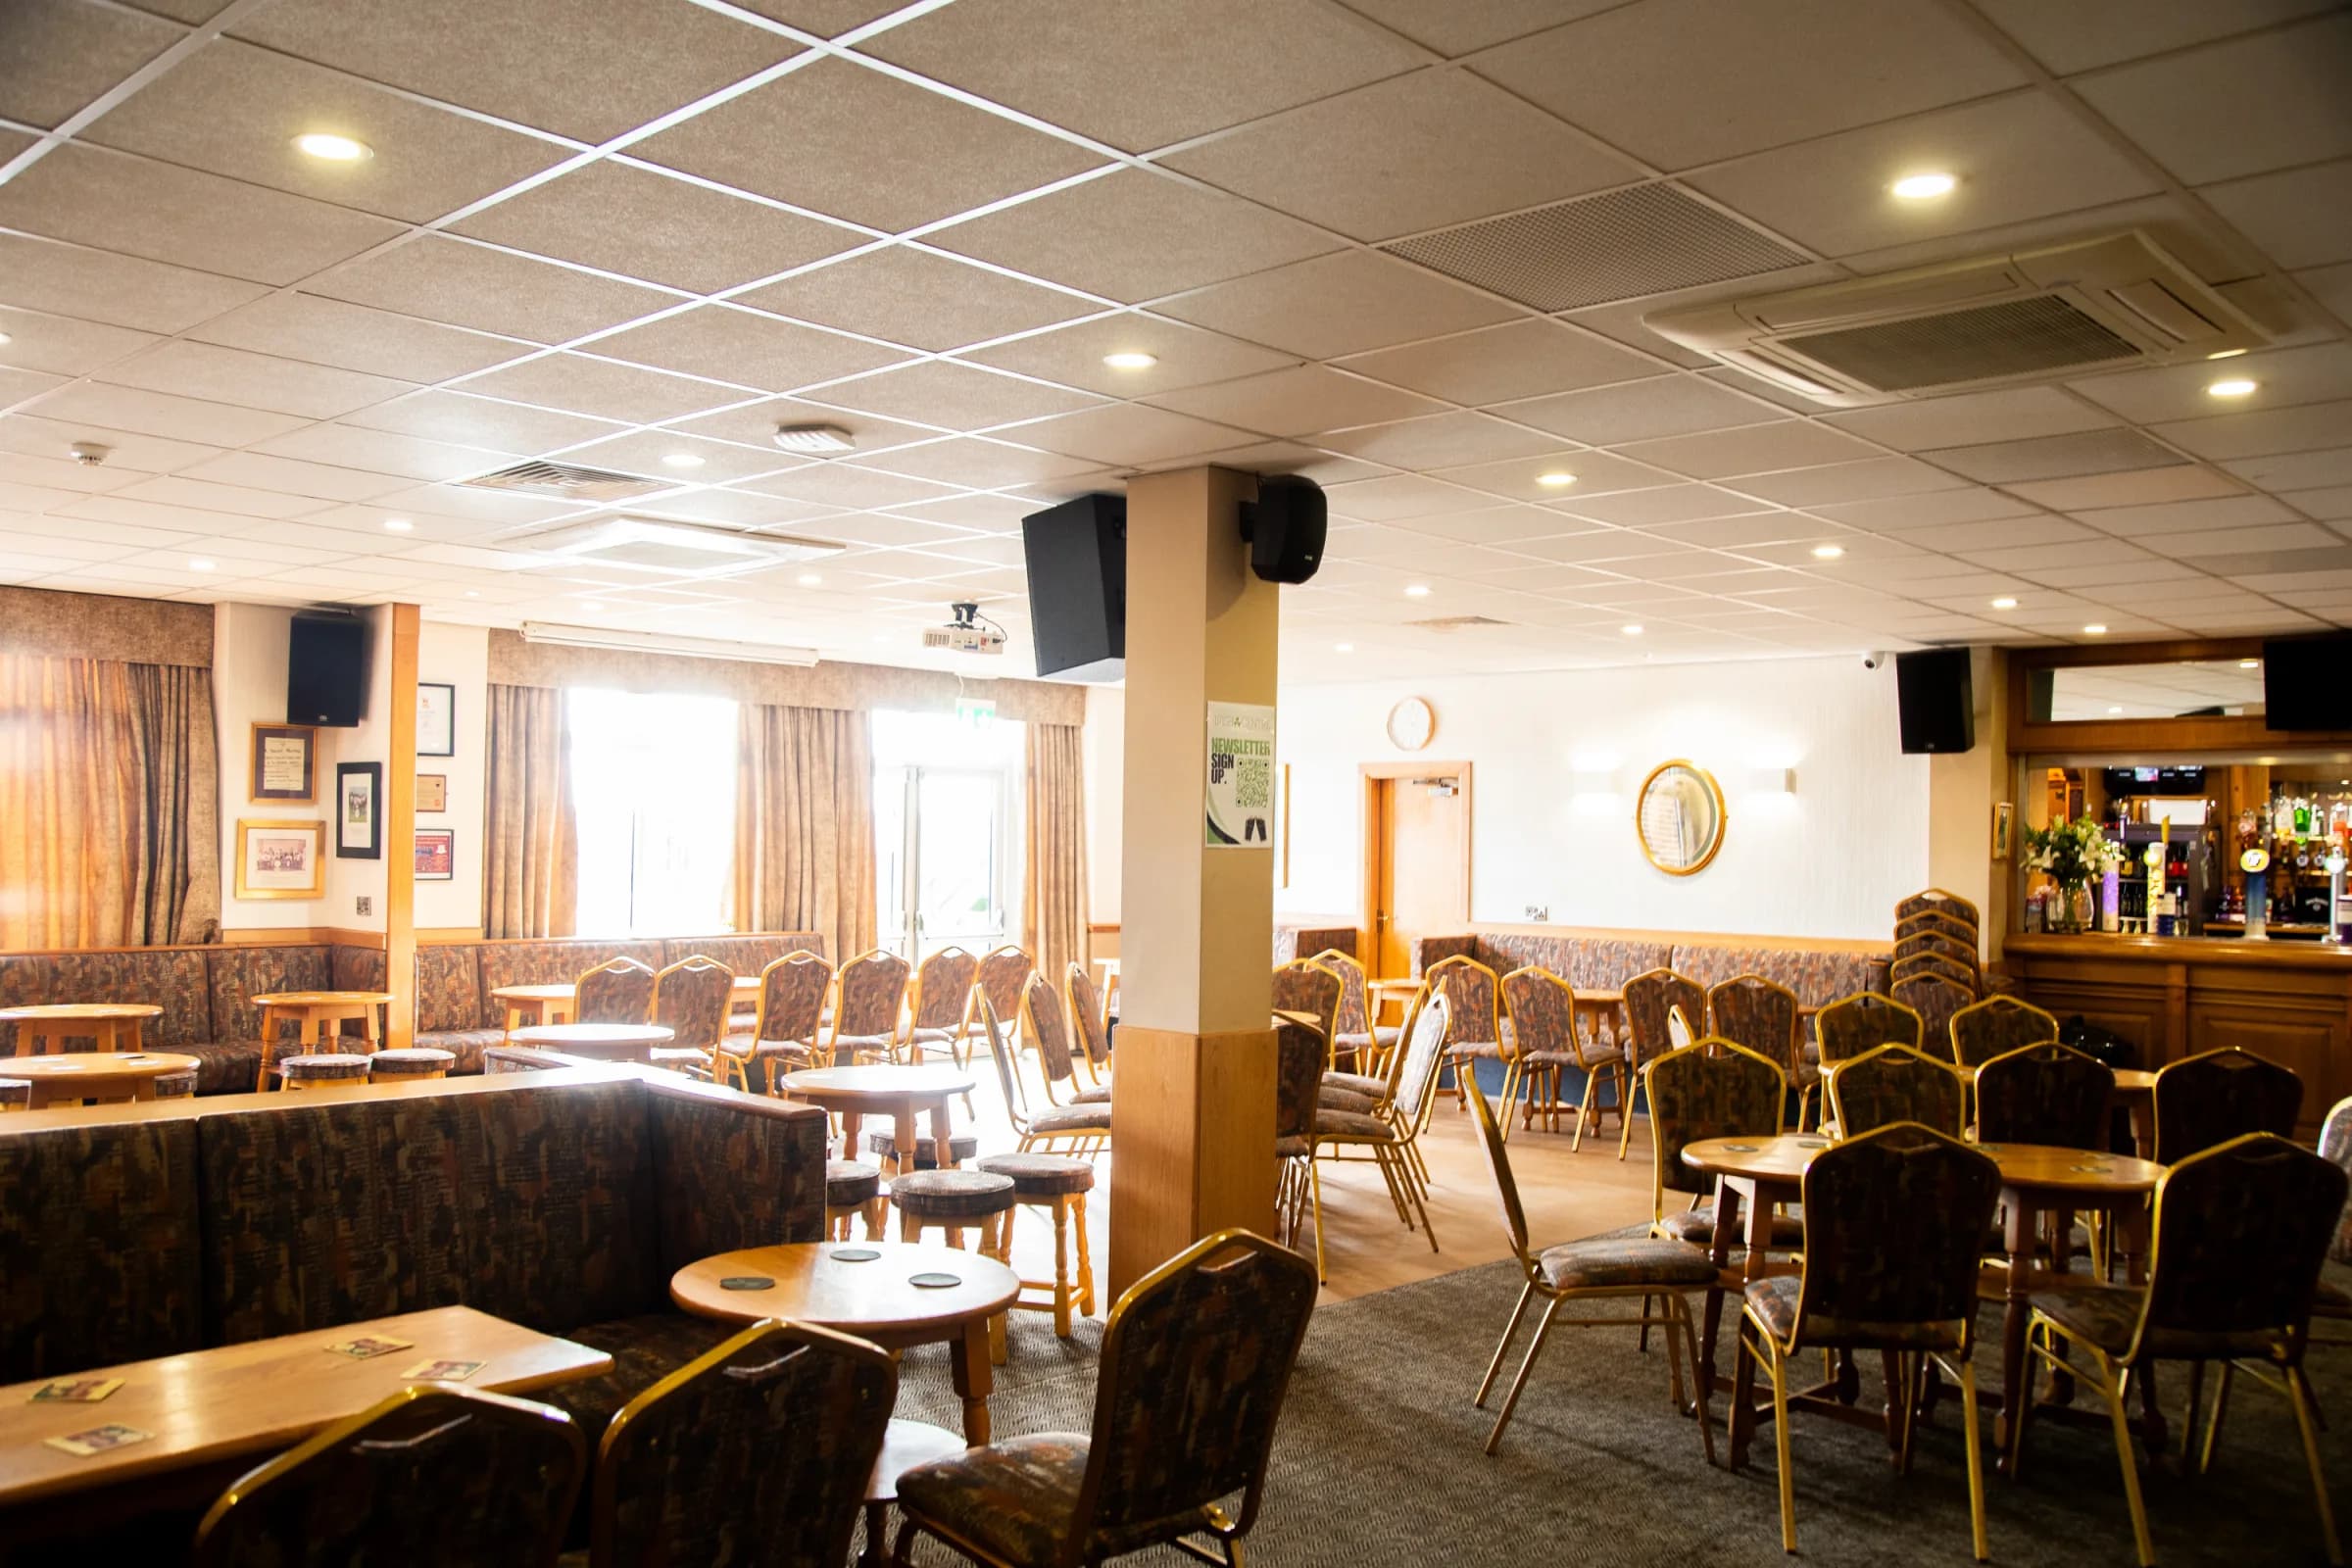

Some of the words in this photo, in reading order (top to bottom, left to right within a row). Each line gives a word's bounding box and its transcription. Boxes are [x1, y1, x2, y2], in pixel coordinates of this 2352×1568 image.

[1211, 737, 1270, 756] NEWSLETTER
[1211, 753, 1234, 769] SIGN
[1211, 768, 1227, 784] UP.
